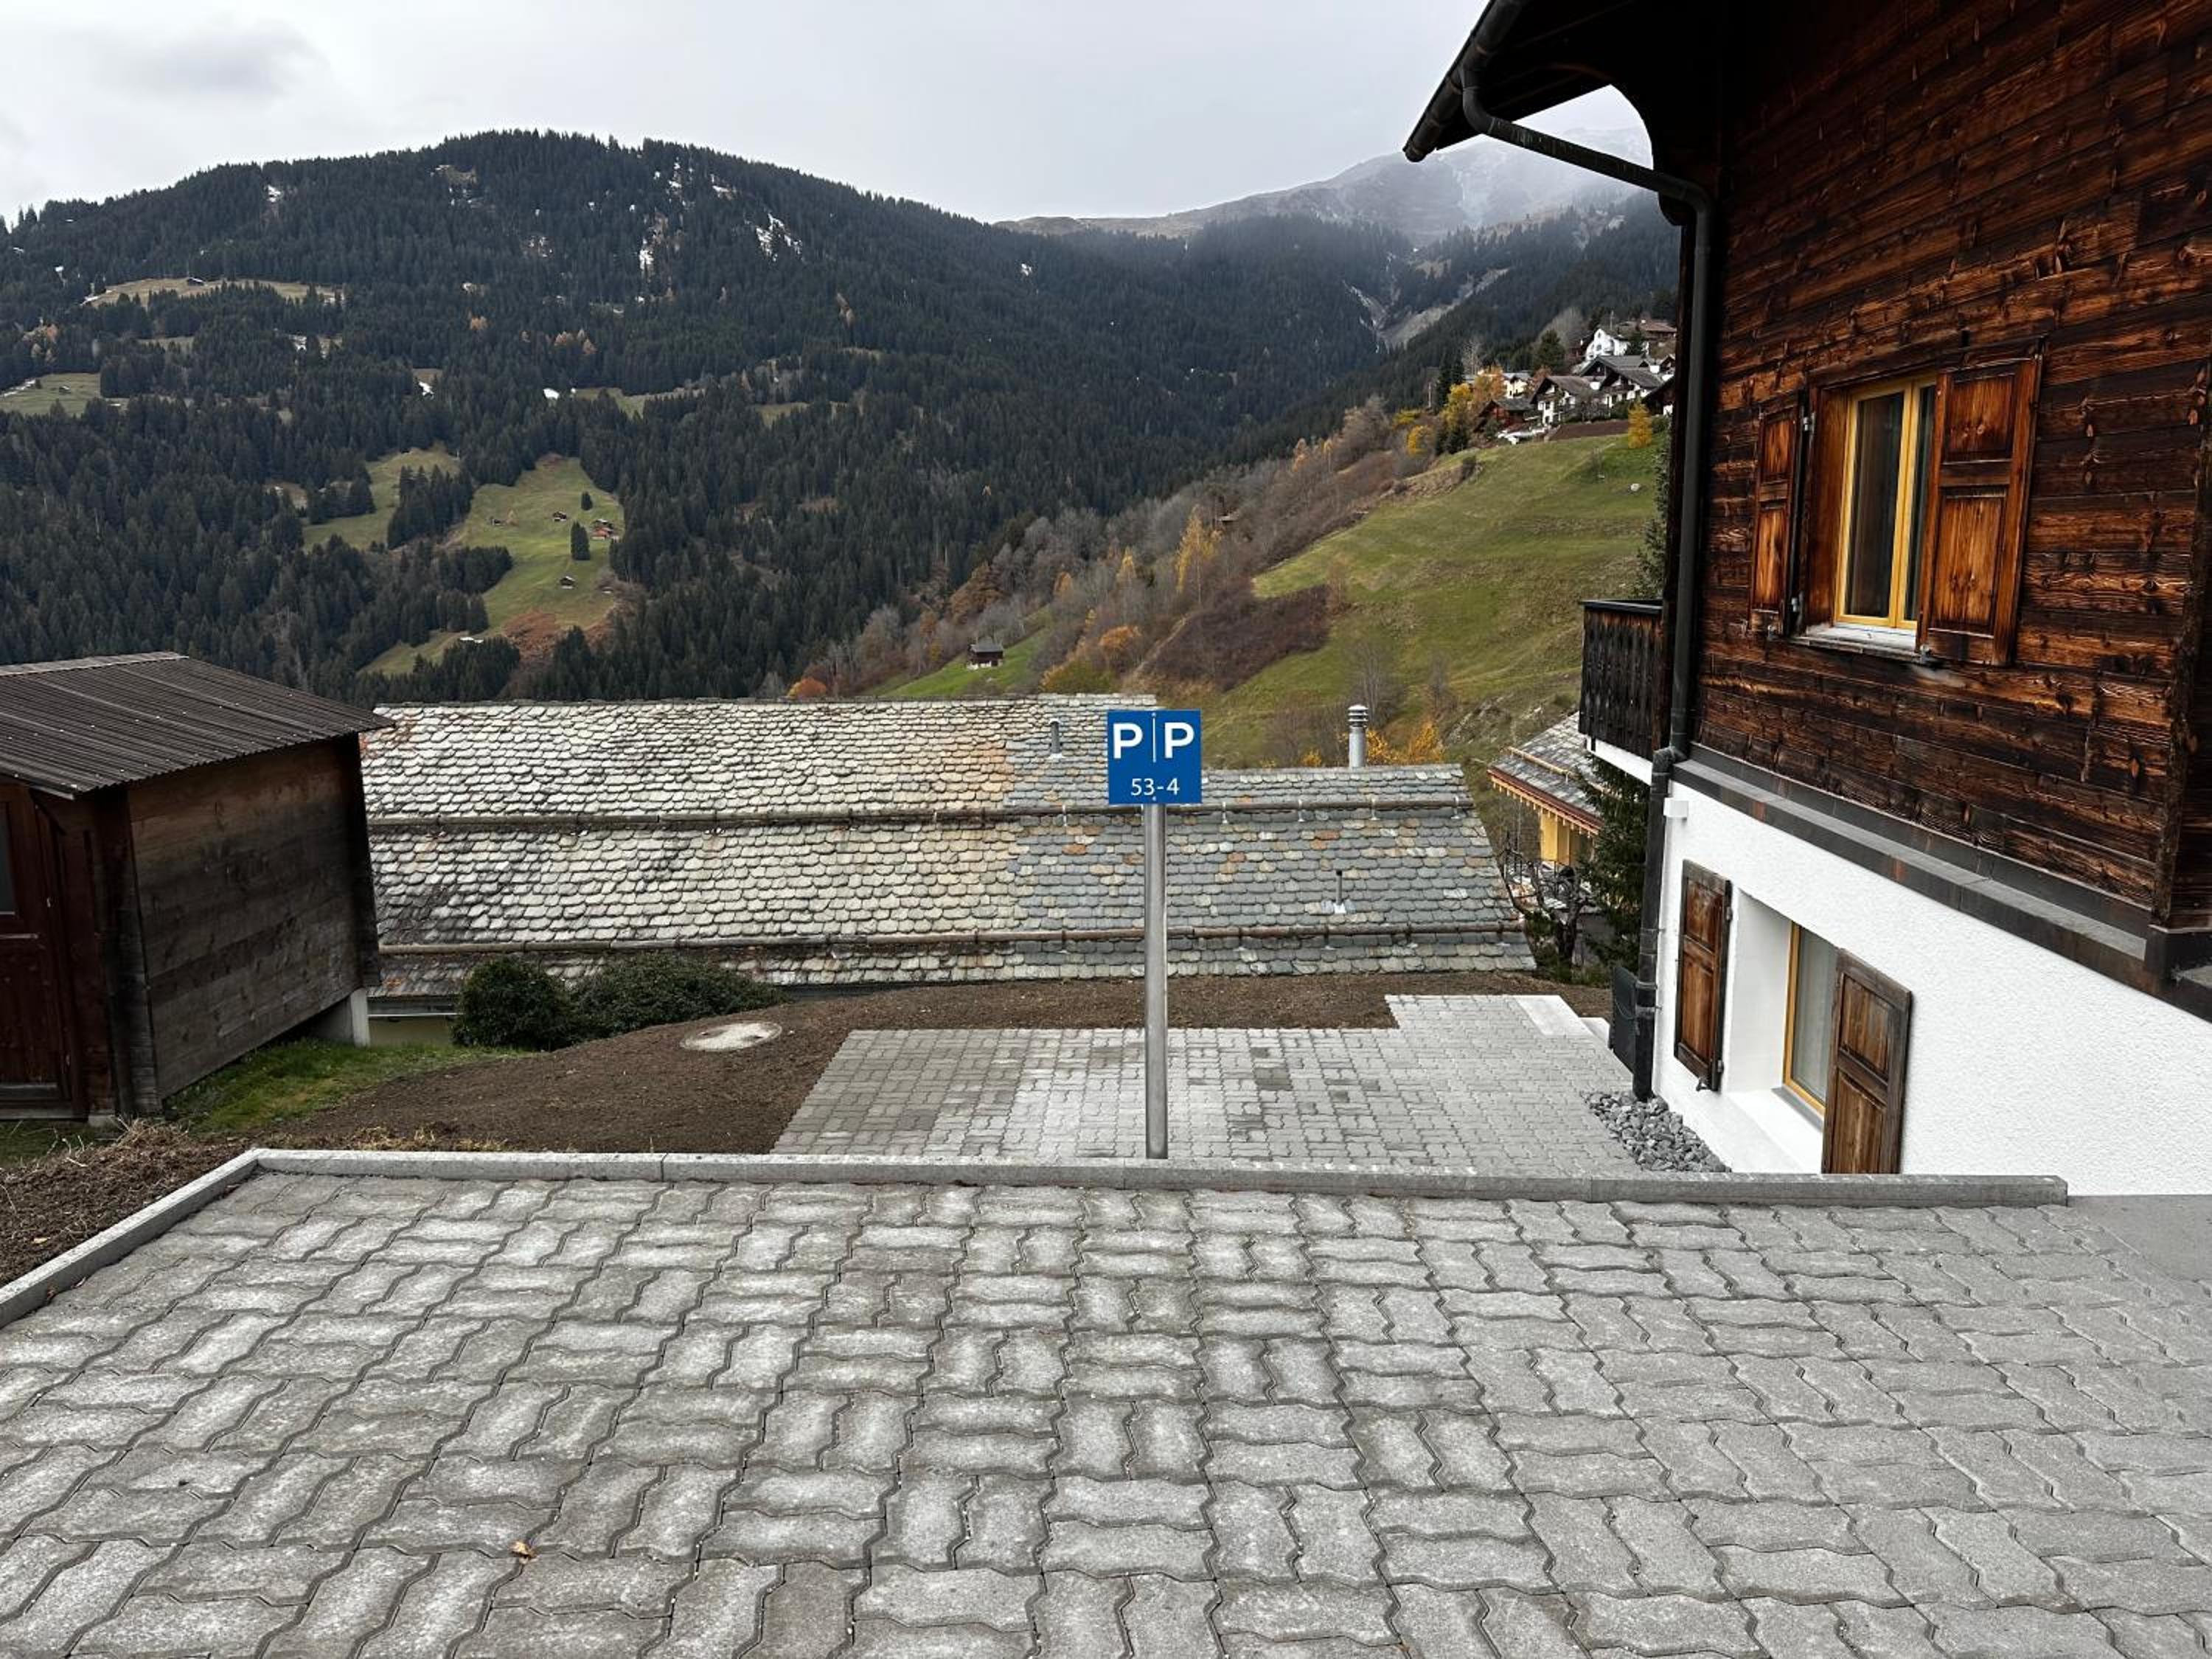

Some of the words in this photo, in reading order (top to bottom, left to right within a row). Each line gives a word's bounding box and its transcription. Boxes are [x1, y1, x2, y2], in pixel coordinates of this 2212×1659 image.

[1113, 723, 1143, 759] P
[1164, 722, 1194, 759] P
[1130, 777, 1180, 796] 53-4
